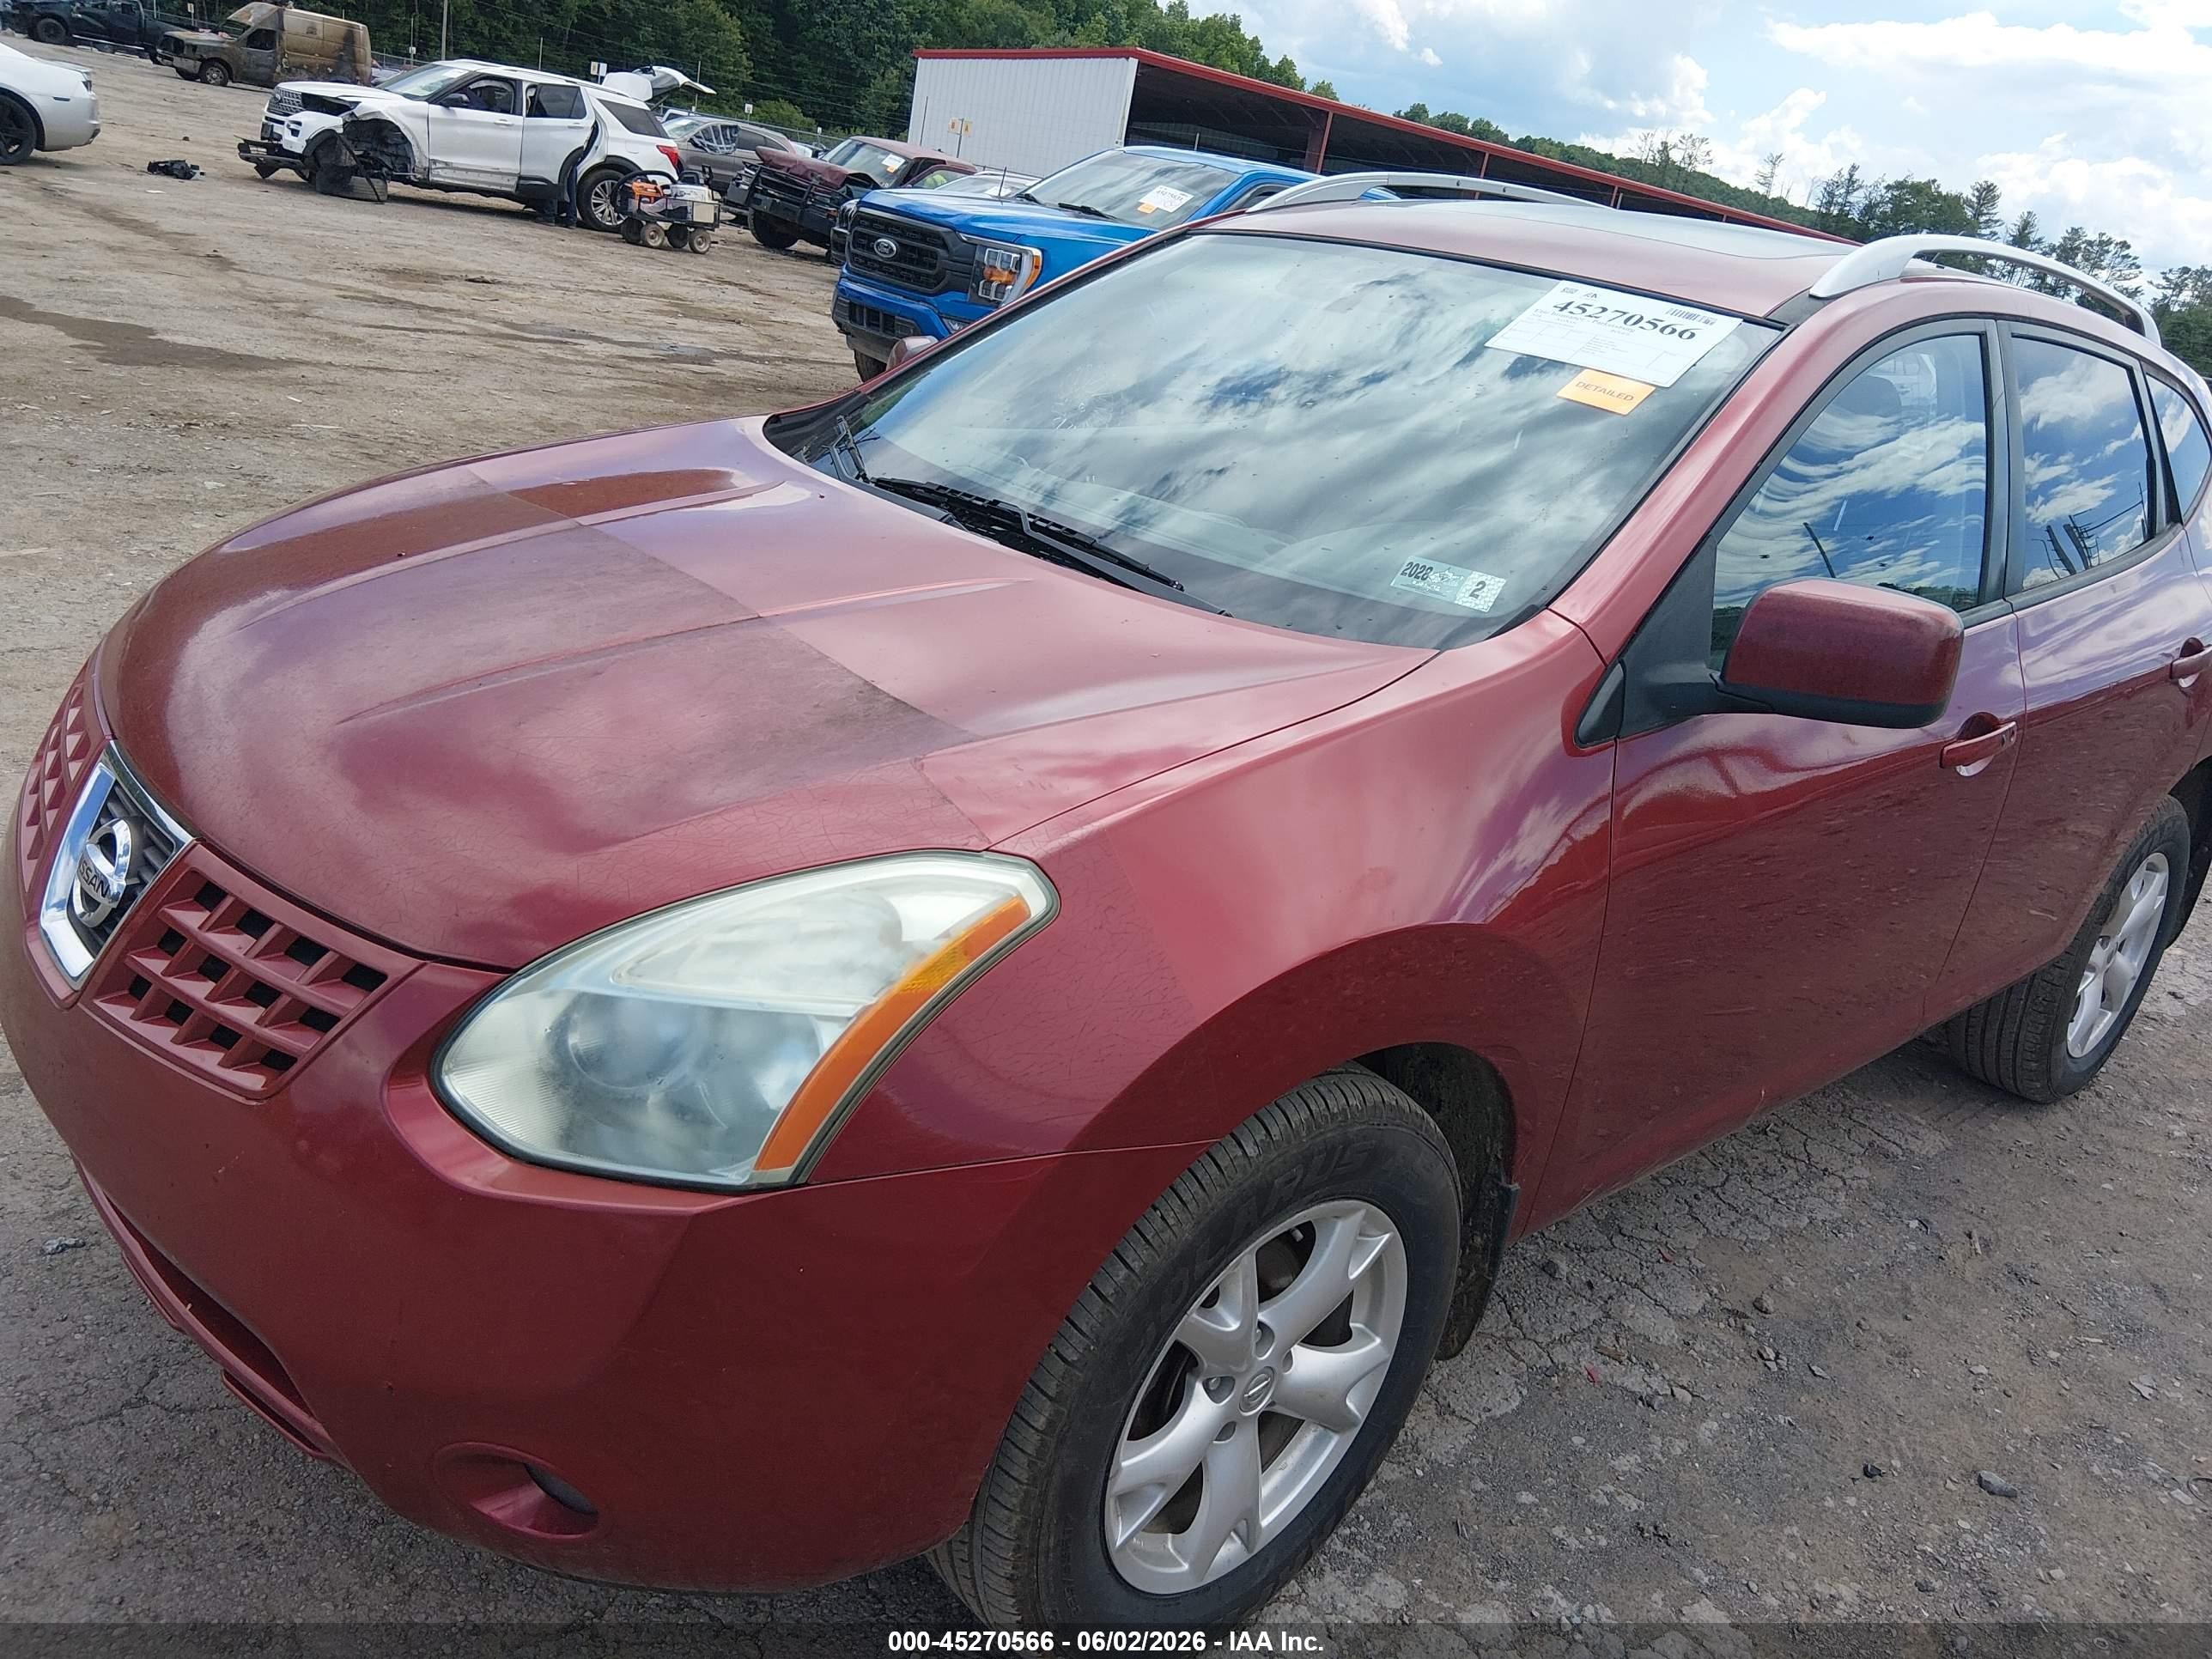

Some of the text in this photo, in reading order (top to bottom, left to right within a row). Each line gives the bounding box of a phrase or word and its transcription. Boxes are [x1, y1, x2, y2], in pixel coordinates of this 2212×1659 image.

[1553, 301, 1703, 340] 45270566
[1576, 381, 1634, 401] DETAILED
[1469, 580, 1486, 599] 2
[79, 860, 110, 898] SSAN
